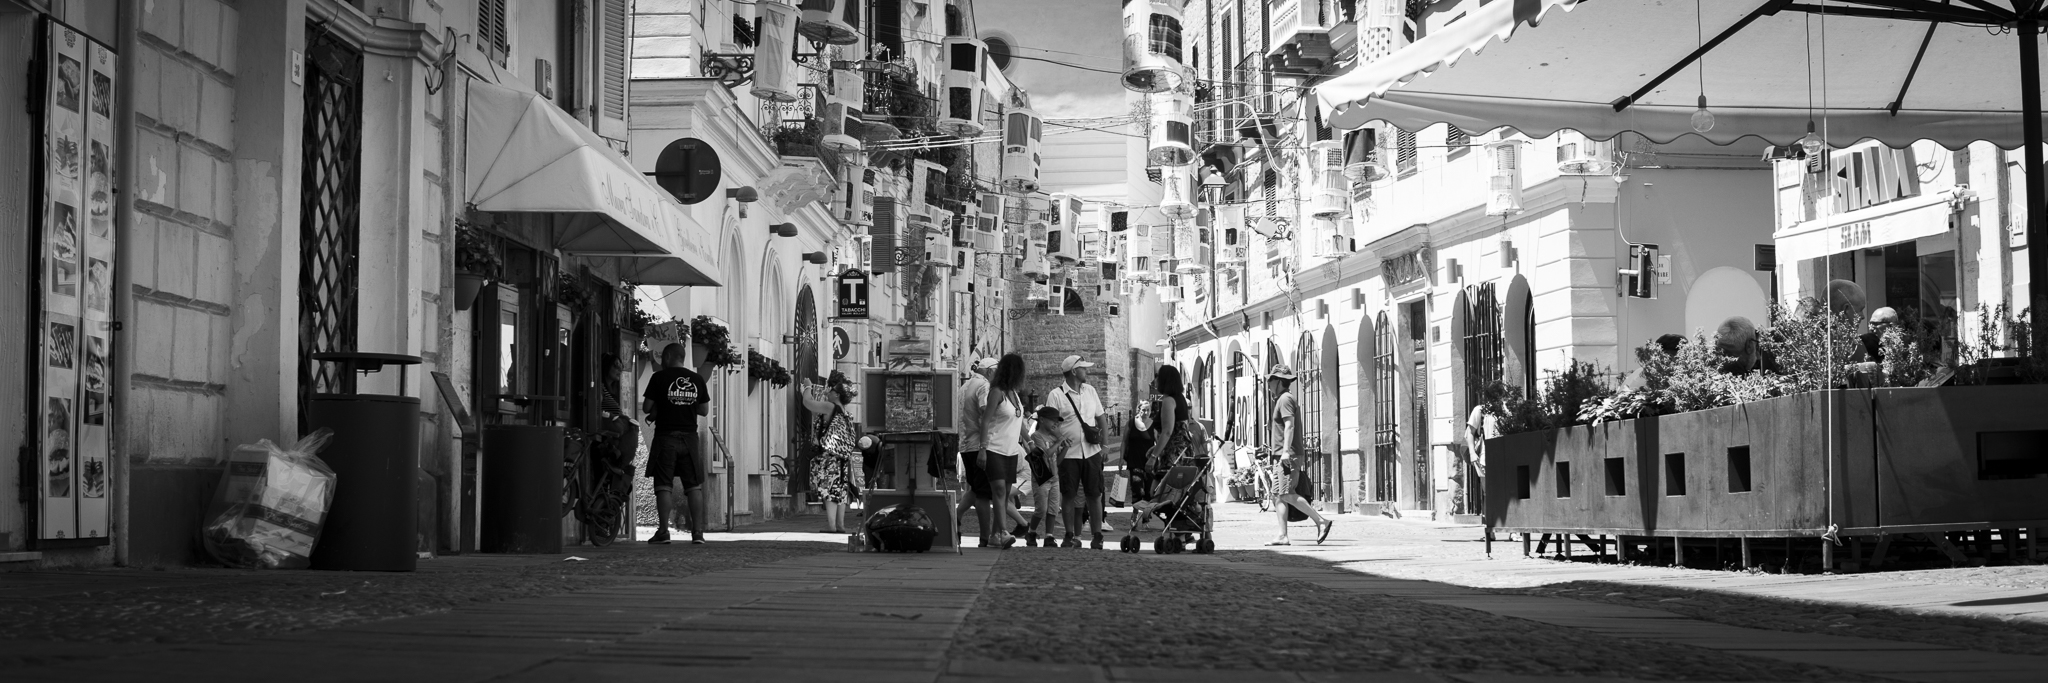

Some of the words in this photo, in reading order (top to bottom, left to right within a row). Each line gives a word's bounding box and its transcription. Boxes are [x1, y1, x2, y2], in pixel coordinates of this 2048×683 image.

[1831, 144, 1919, 213] SLAM
[1841, 222, 1871, 249] SLAM
[842, 279, 863, 303] T
[667, 389, 698, 398] adamo
